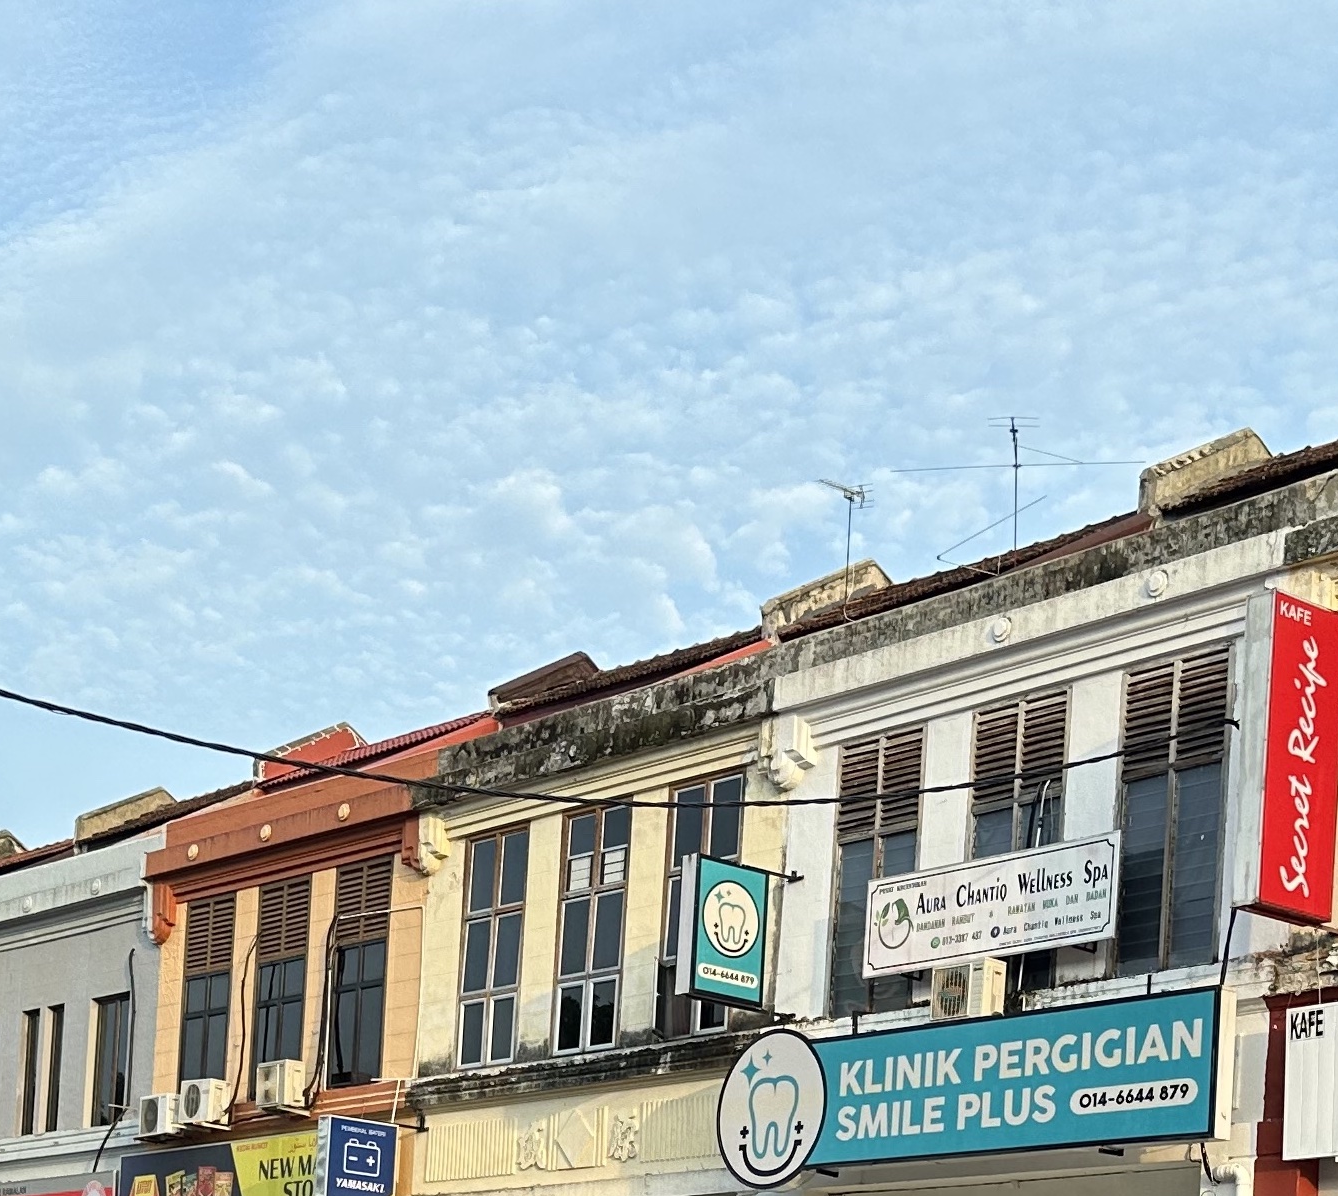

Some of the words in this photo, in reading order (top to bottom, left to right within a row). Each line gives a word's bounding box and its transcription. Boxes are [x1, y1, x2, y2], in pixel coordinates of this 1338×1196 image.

[1280, 600, 1312, 627] KAFE
[1288, 635, 1328, 764] Recipe
[1280, 774, 1313, 898] Secret
[1007, 902, 1035, 916] RAWATAN
[1043, 898, 1058, 910] MUKA
[1066, 894, 1078, 905] DAN
[1086, 889, 1107, 901] BADAN
[703, 966, 739, 981] 014-6644
[740, 975, 755, 985] 879
[1289, 1009, 1324, 1040] KAFE
[839, 1048, 961, 1096] KLINIK
[974, 1018, 1203, 1082] PERGIGIAN
[836, 1096, 944, 1141] SMILE
[957, 1084, 1056, 1131] PLUS
[1079, 1086, 1155, 1109] 014-6644
[1160, 1083, 1189, 1100] 879
[259, 1157, 294, 1181] NEW
[336, 1177, 385, 1193] YAMASAKI
